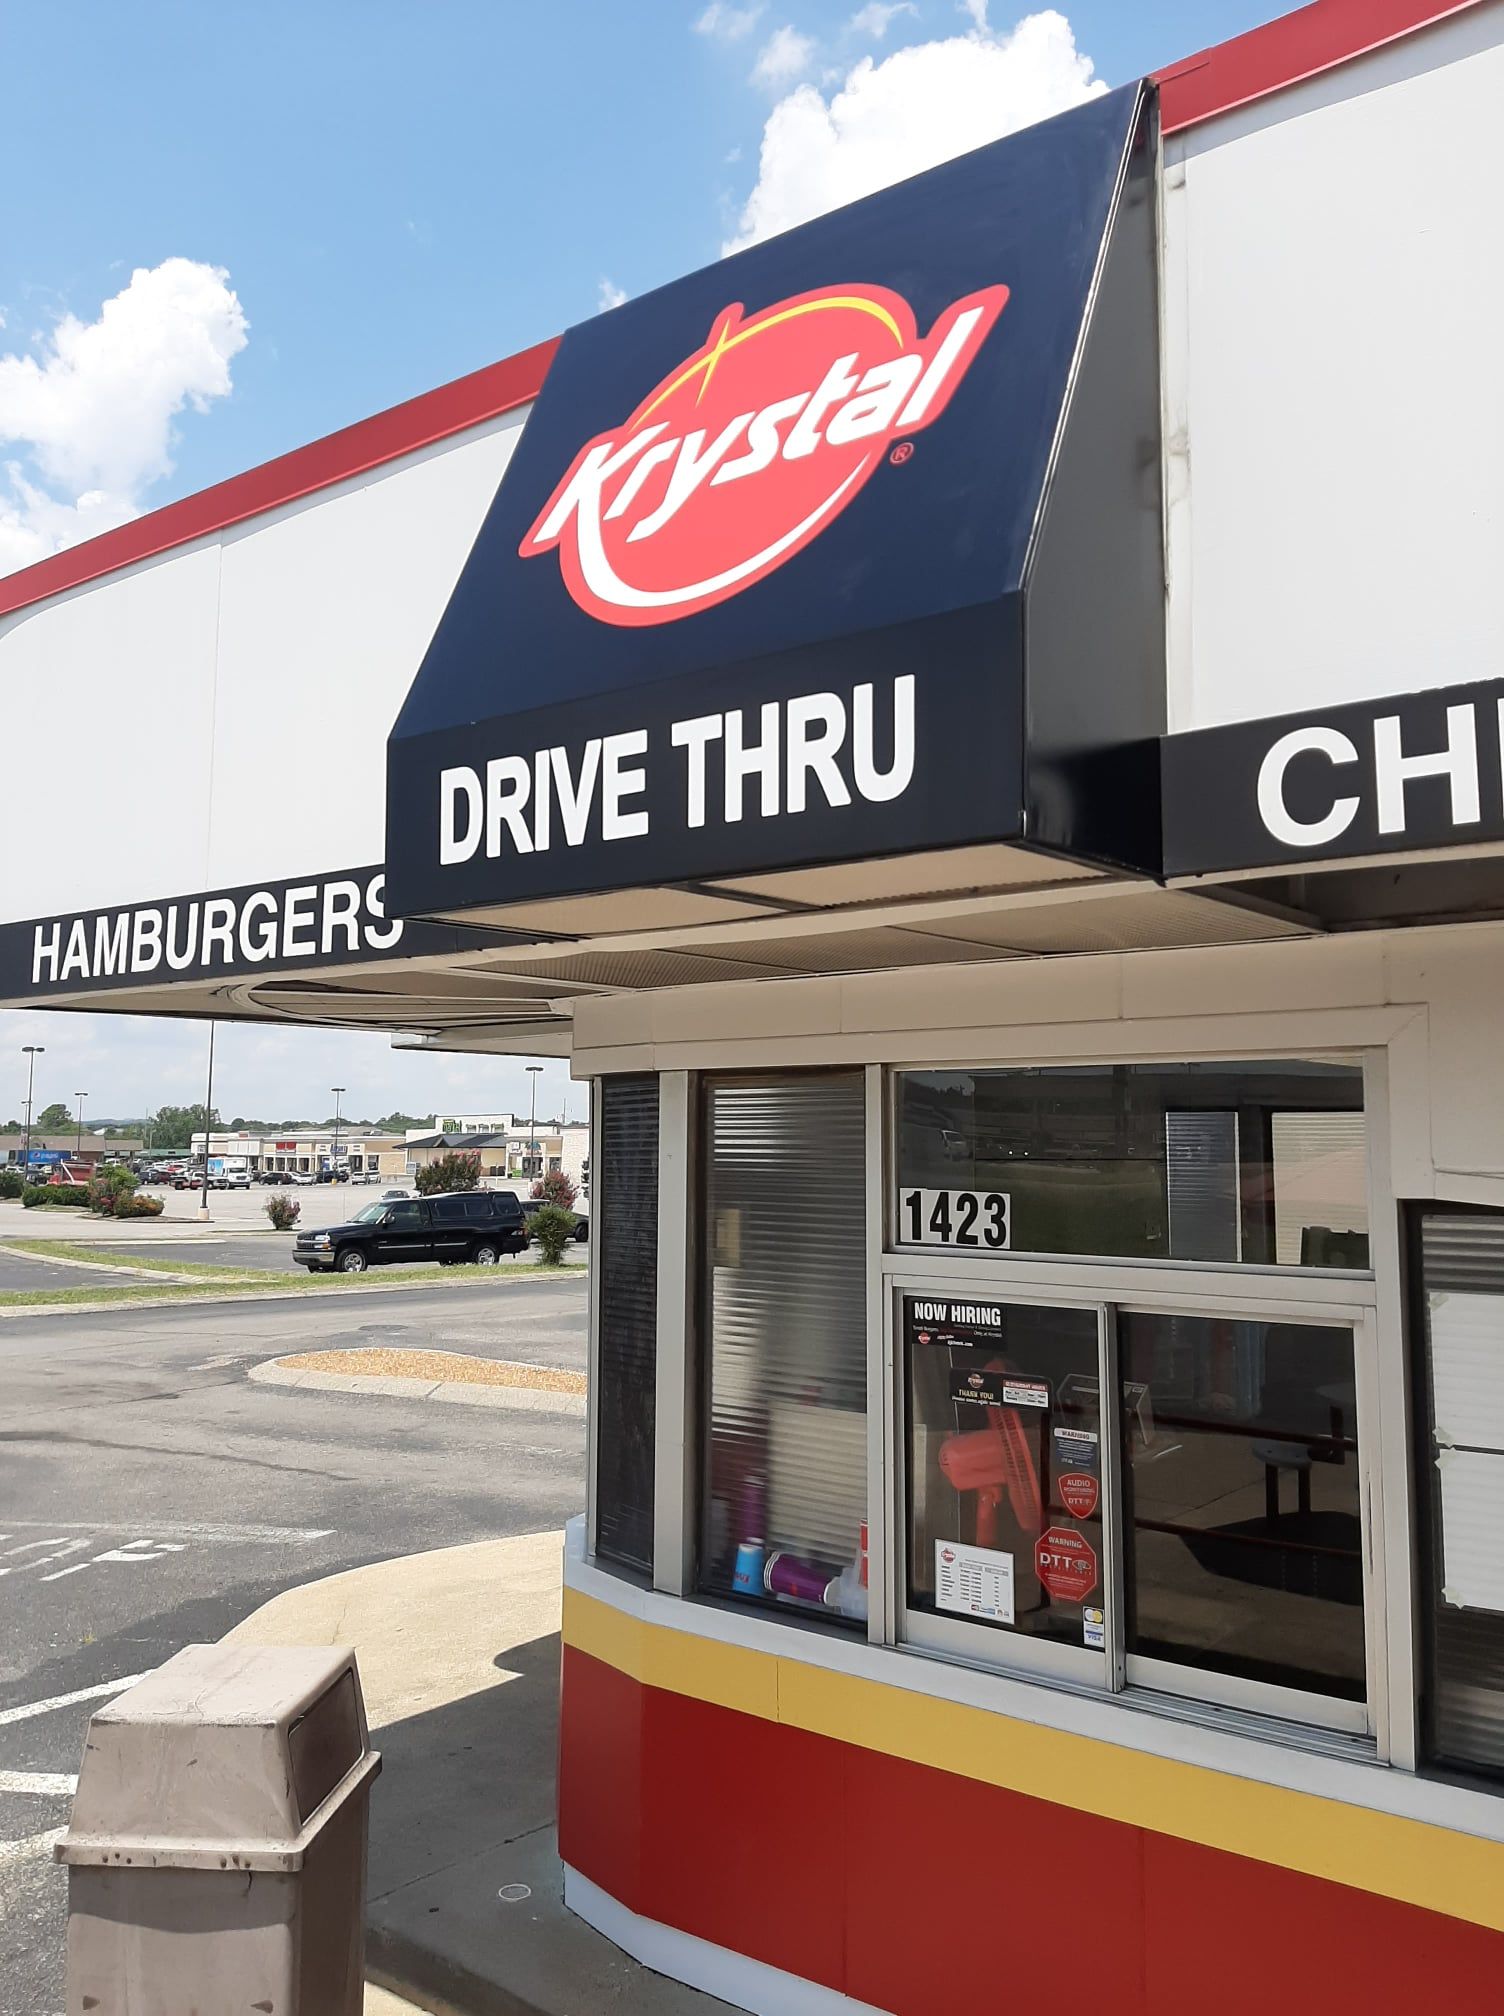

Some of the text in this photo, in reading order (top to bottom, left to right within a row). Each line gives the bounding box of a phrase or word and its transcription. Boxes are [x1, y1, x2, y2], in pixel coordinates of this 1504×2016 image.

[533, 306, 984, 607] Krystal
[440, 674, 915, 866] DRIVE THRU
[1257, 697, 1504, 847] CH
[32, 873, 404, 984] HAMBURGERS
[905, 1190, 1007, 1248] 1423
[914, 1302, 1001, 1326] NOW HIRING
[959, 1389, 978, 1398] THANK
[1067, 1479, 1091, 1487] AUDIO
[1040, 1552, 1072, 1569] DTT
[1048, 1536, 1083, 1548] WARNING
